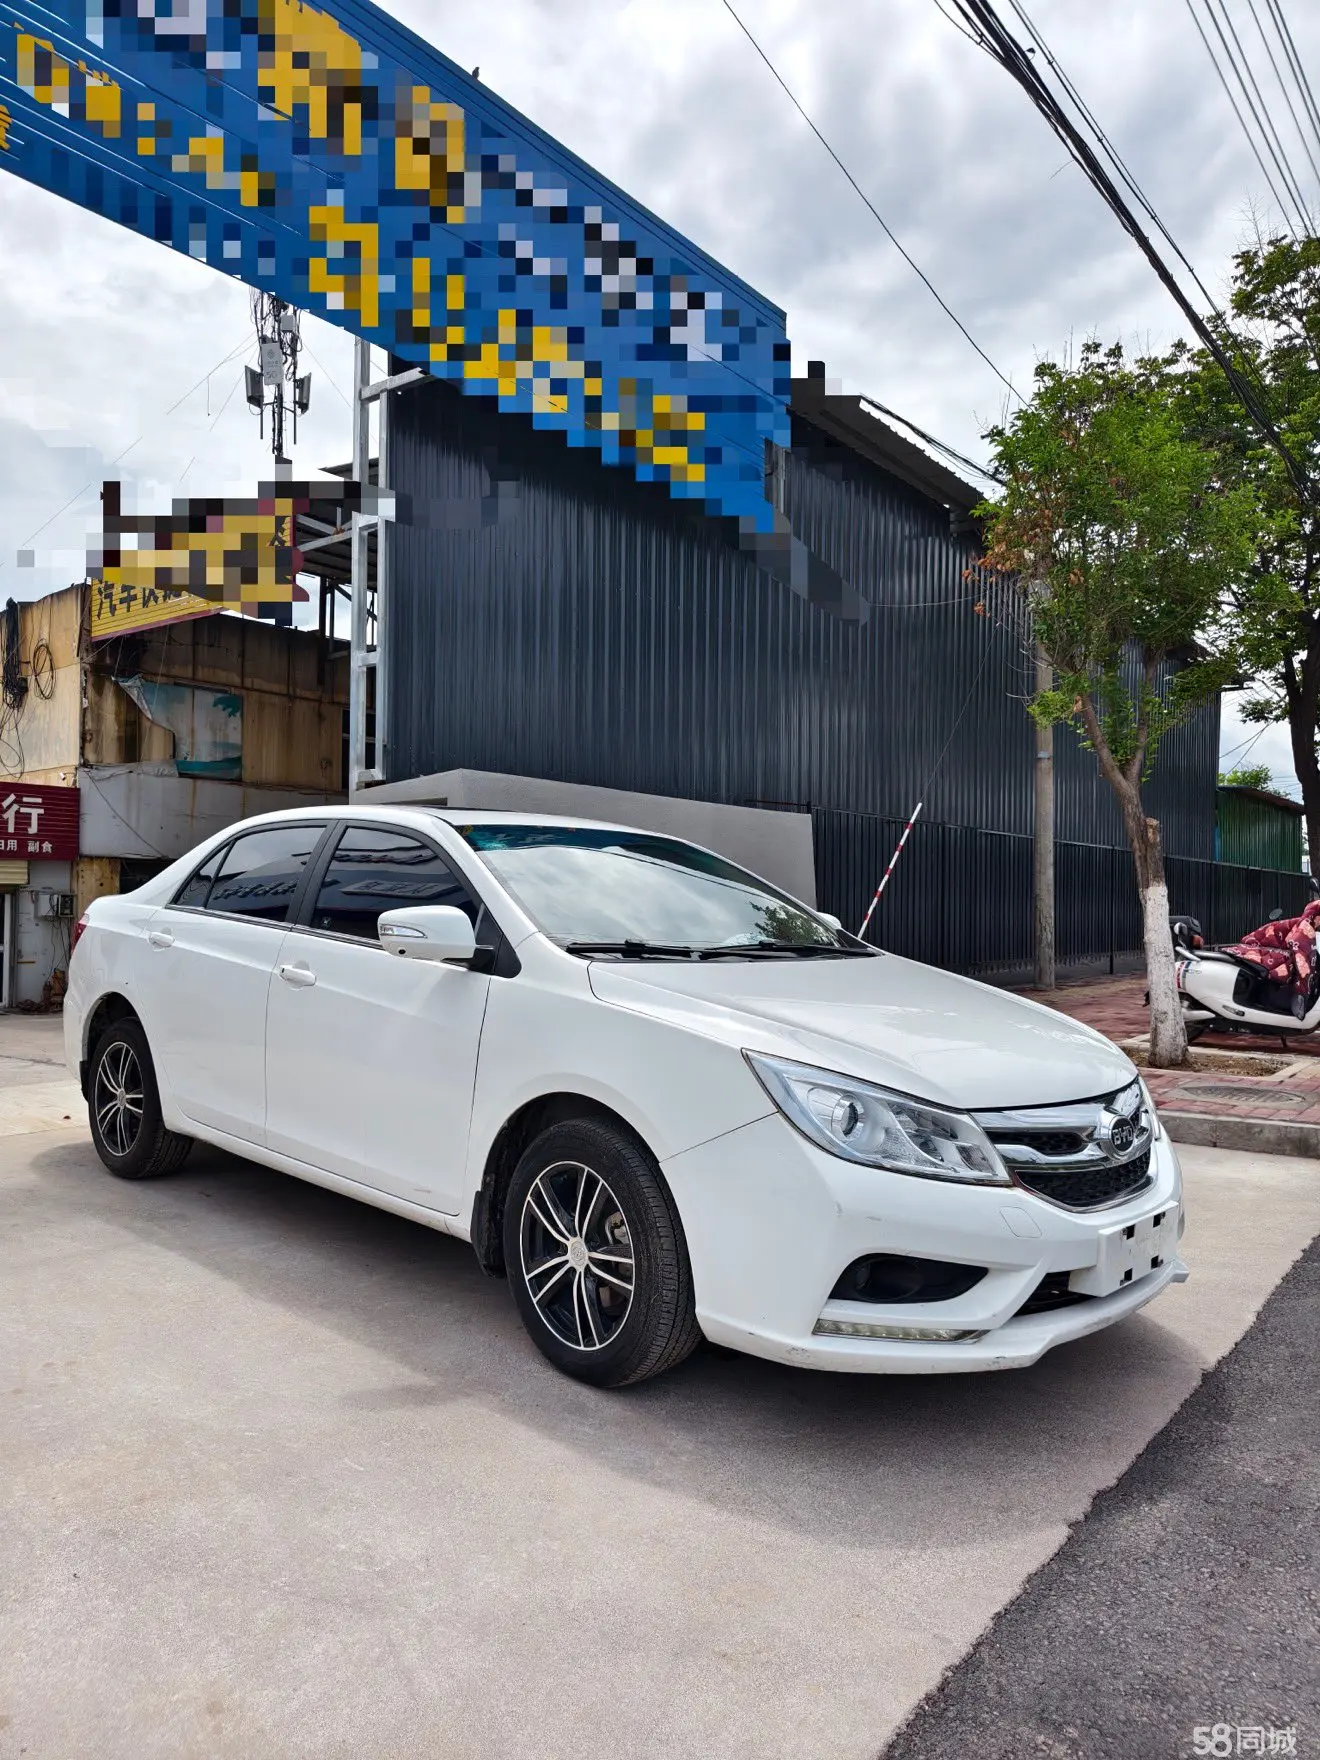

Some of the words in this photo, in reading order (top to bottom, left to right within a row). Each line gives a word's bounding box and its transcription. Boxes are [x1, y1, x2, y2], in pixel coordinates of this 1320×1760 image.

[1, 793, 45, 835] 行
[27, 840, 53, 854] 副食
[1112, 1126, 1133, 1145] BYD
